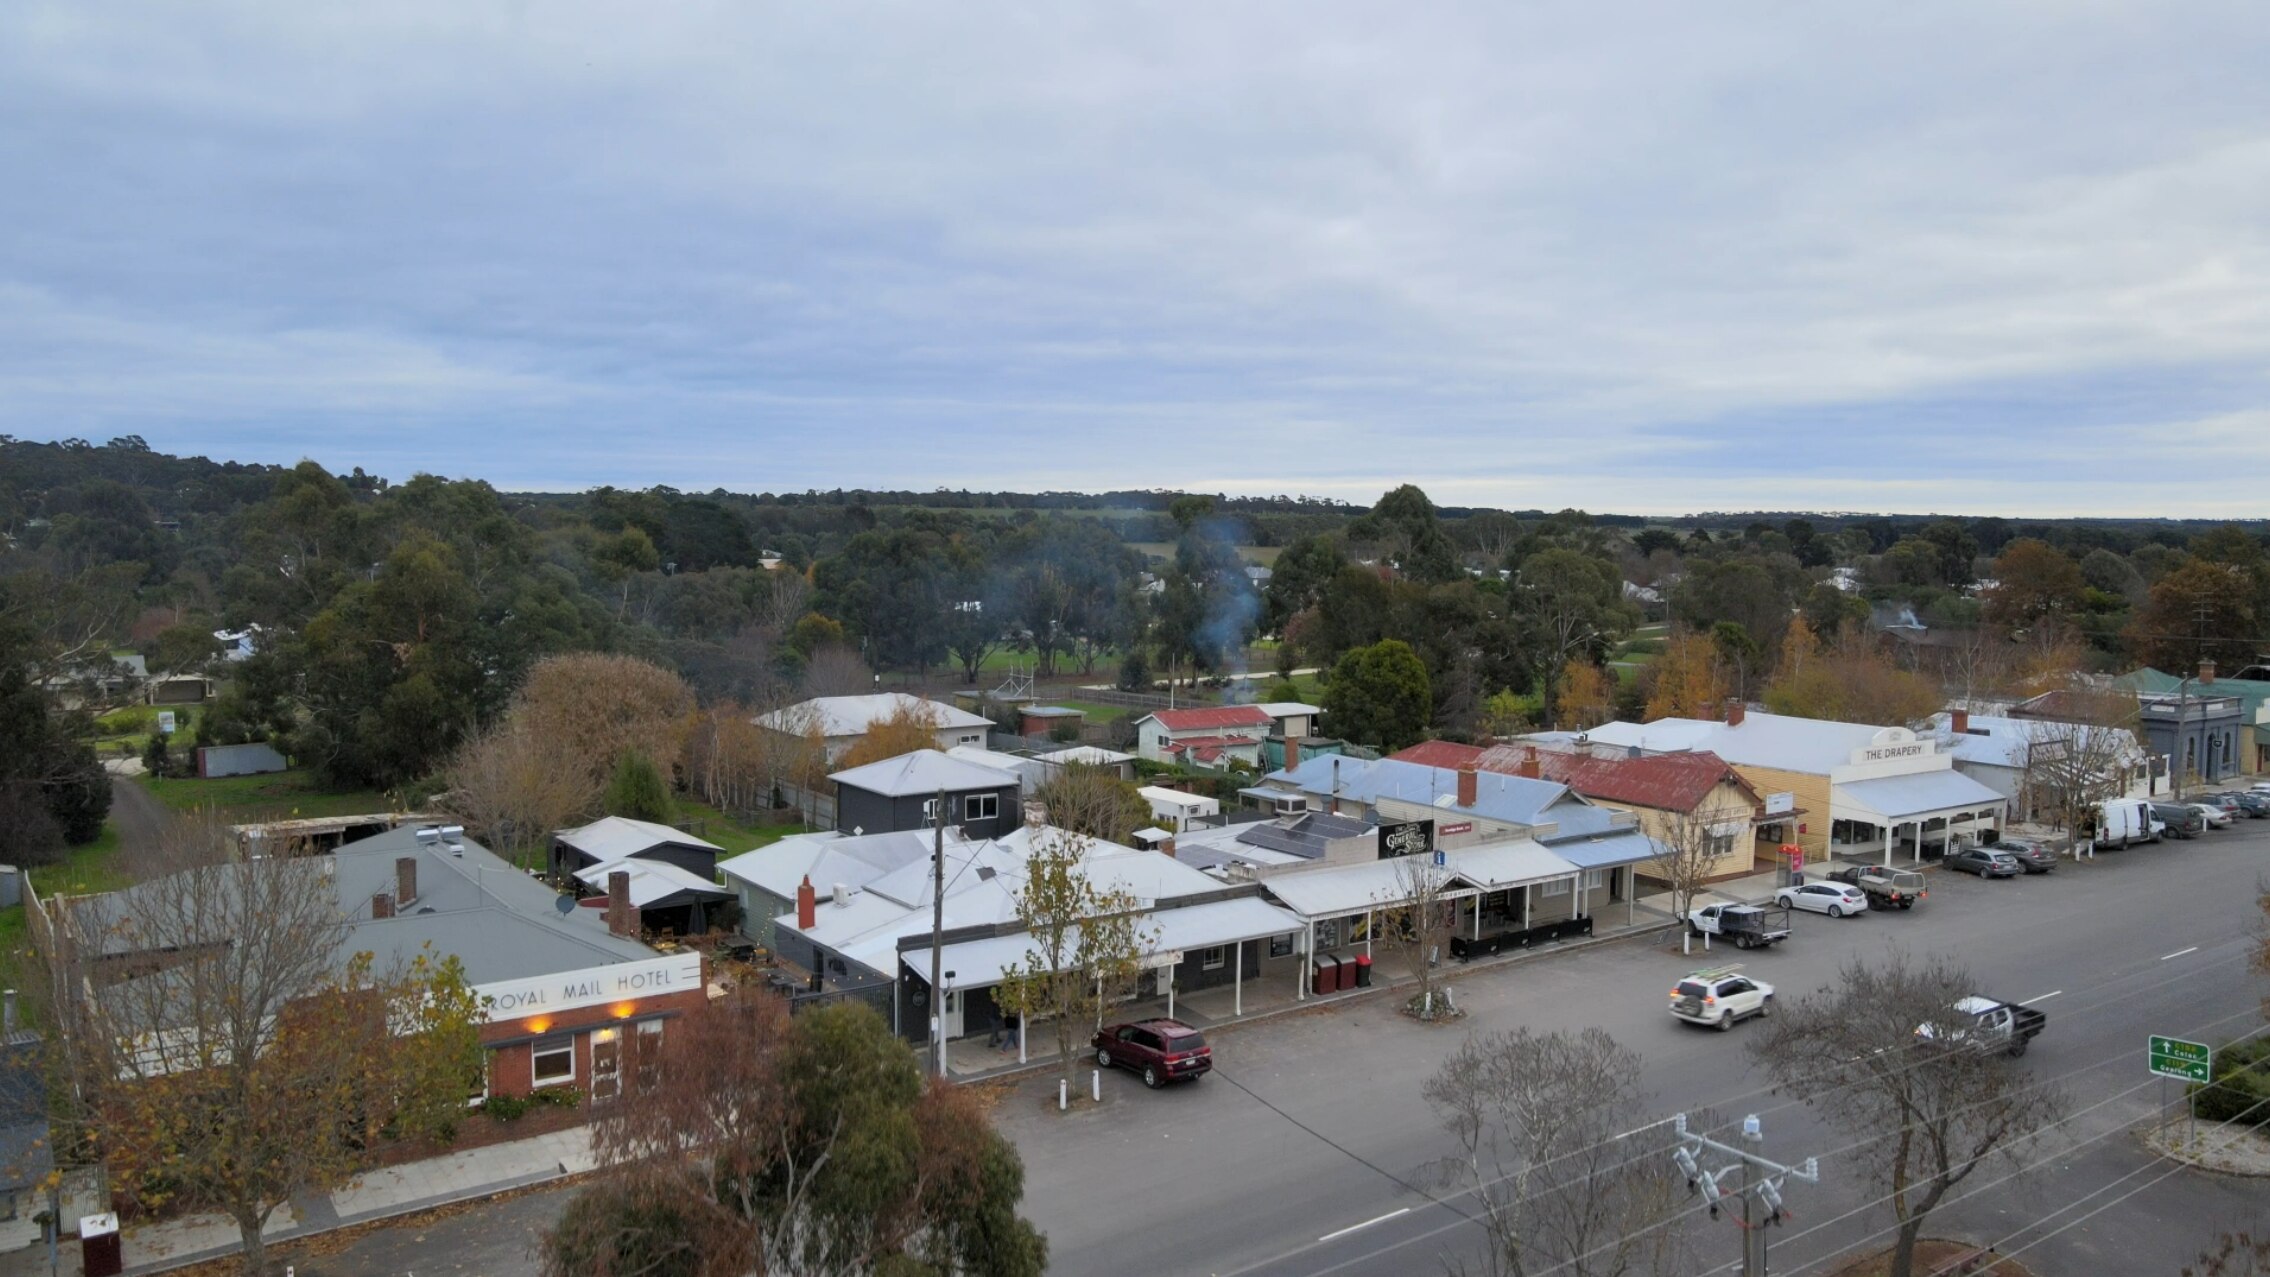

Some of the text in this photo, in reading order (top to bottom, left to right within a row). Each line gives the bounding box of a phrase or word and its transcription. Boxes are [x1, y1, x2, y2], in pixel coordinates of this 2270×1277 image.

[1866, 745, 1922, 760] THE DRAPERY
[490, 969, 672, 1011] ROYAL MAIL HOTEL
[2160, 1064, 2192, 1077] Geelong
